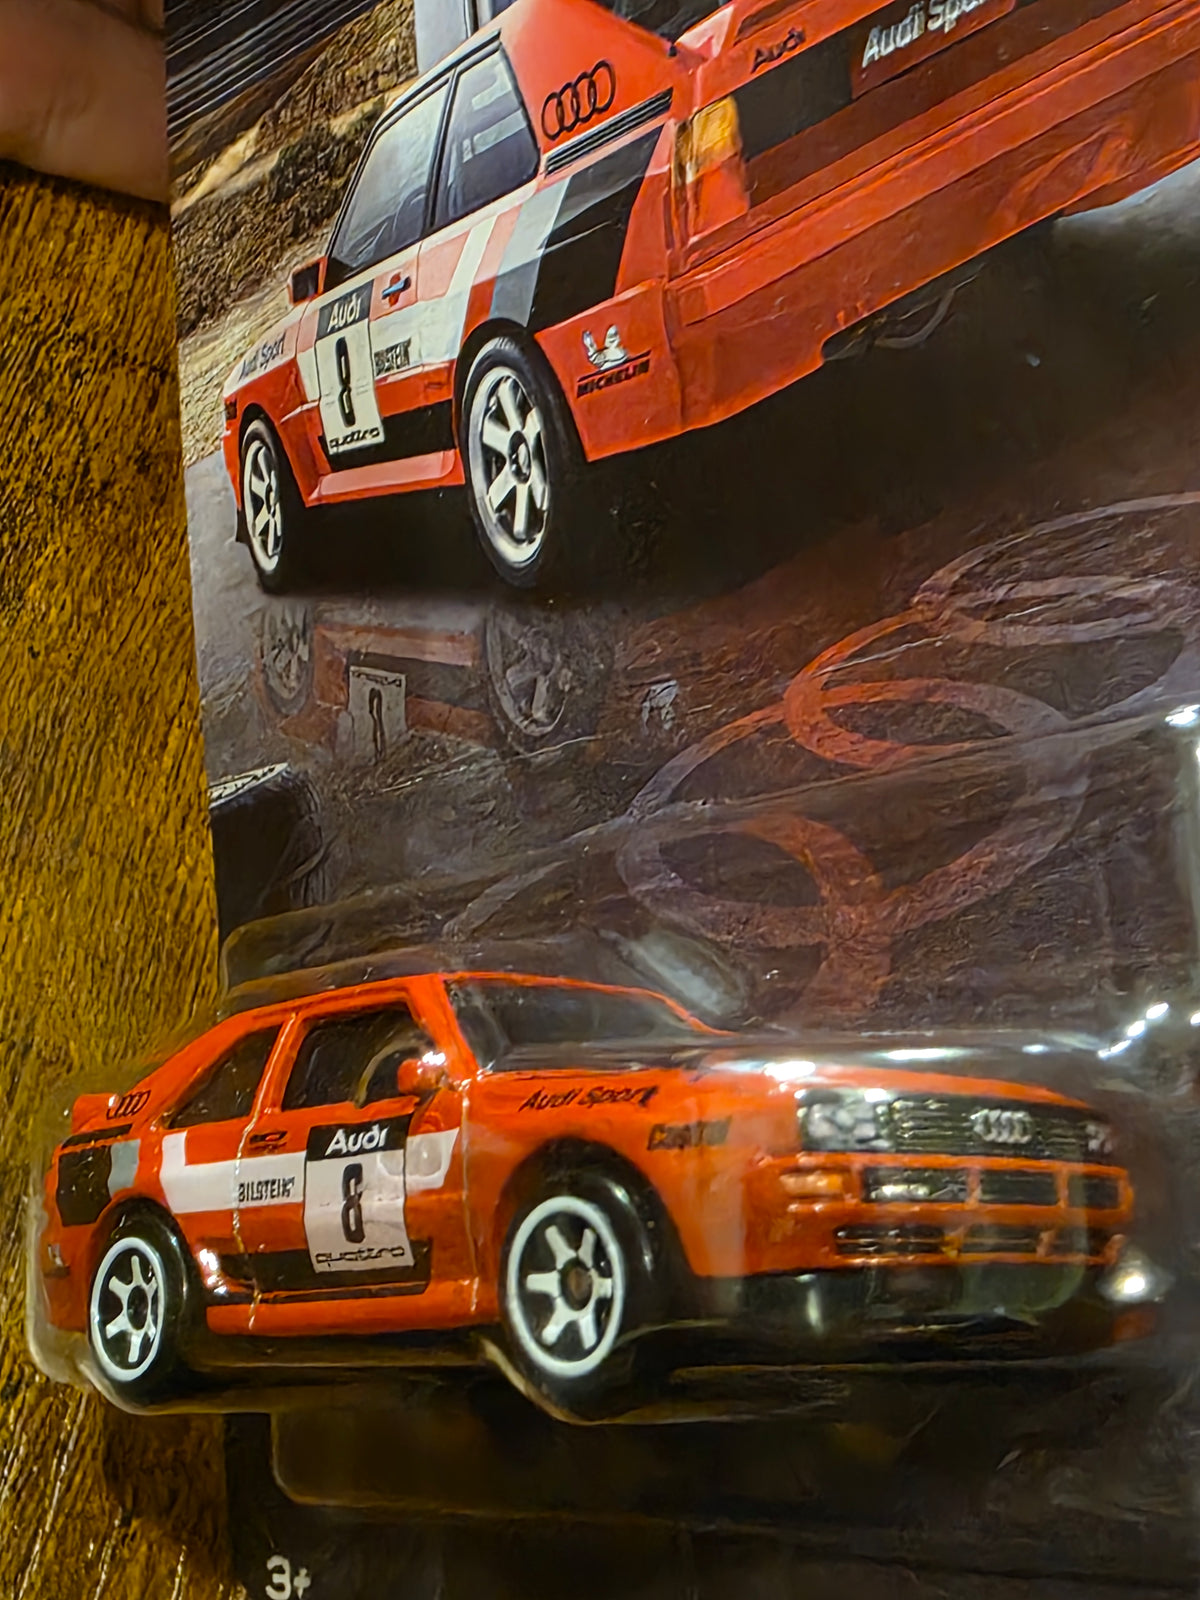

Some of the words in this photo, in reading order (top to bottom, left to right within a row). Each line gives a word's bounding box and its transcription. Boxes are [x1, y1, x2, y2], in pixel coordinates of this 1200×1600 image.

[862, 0, 925, 68] Audi
[326, 292, 362, 333] Audi
[335, 336, 356, 428] 8
[325, 1124, 391, 1156] Audi
[238, 1176, 296, 1203] BILSTEIN
[341, 1162, 366, 1244] 8
[315, 1246, 405, 1267] quattro
[265, 1555, 311, 1600] 3+
